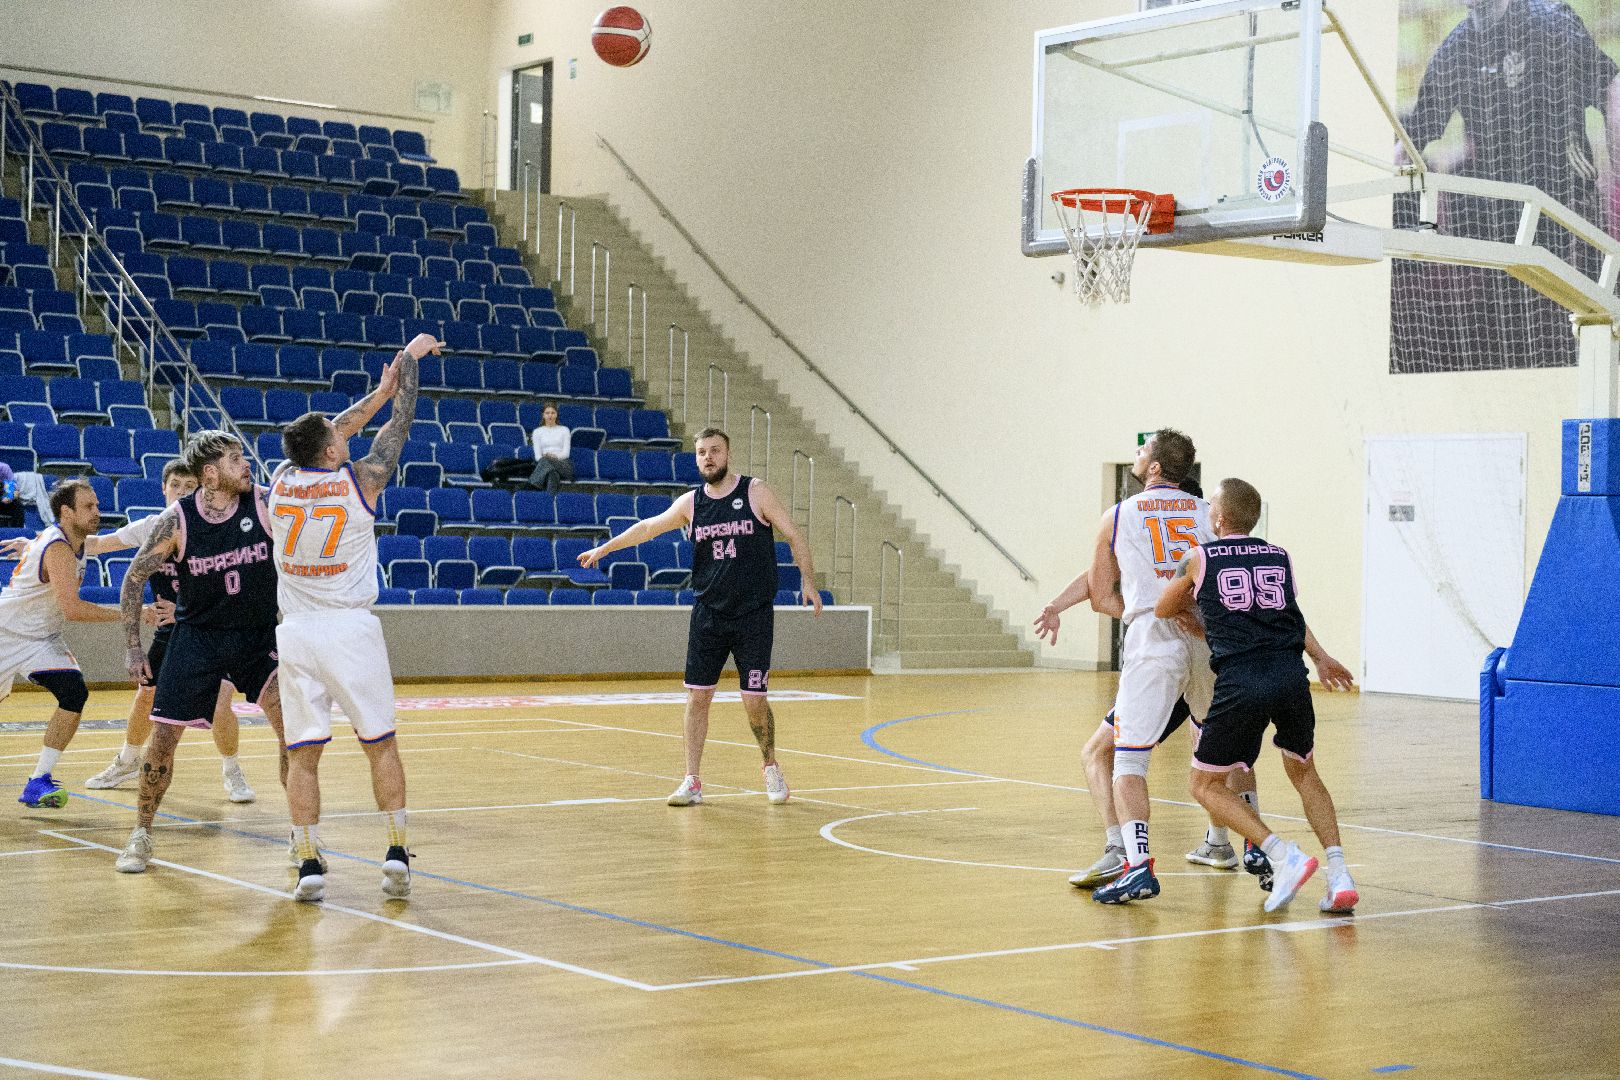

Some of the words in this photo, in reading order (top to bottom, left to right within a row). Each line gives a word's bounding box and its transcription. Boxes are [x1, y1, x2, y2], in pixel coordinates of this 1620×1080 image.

[273, 503, 349, 558] 77
[712, 538, 737, 560] 84
[1143, 516, 1199, 565] 15
[224, 570, 241, 595] 0
[1217, 565, 1287, 612] 95
